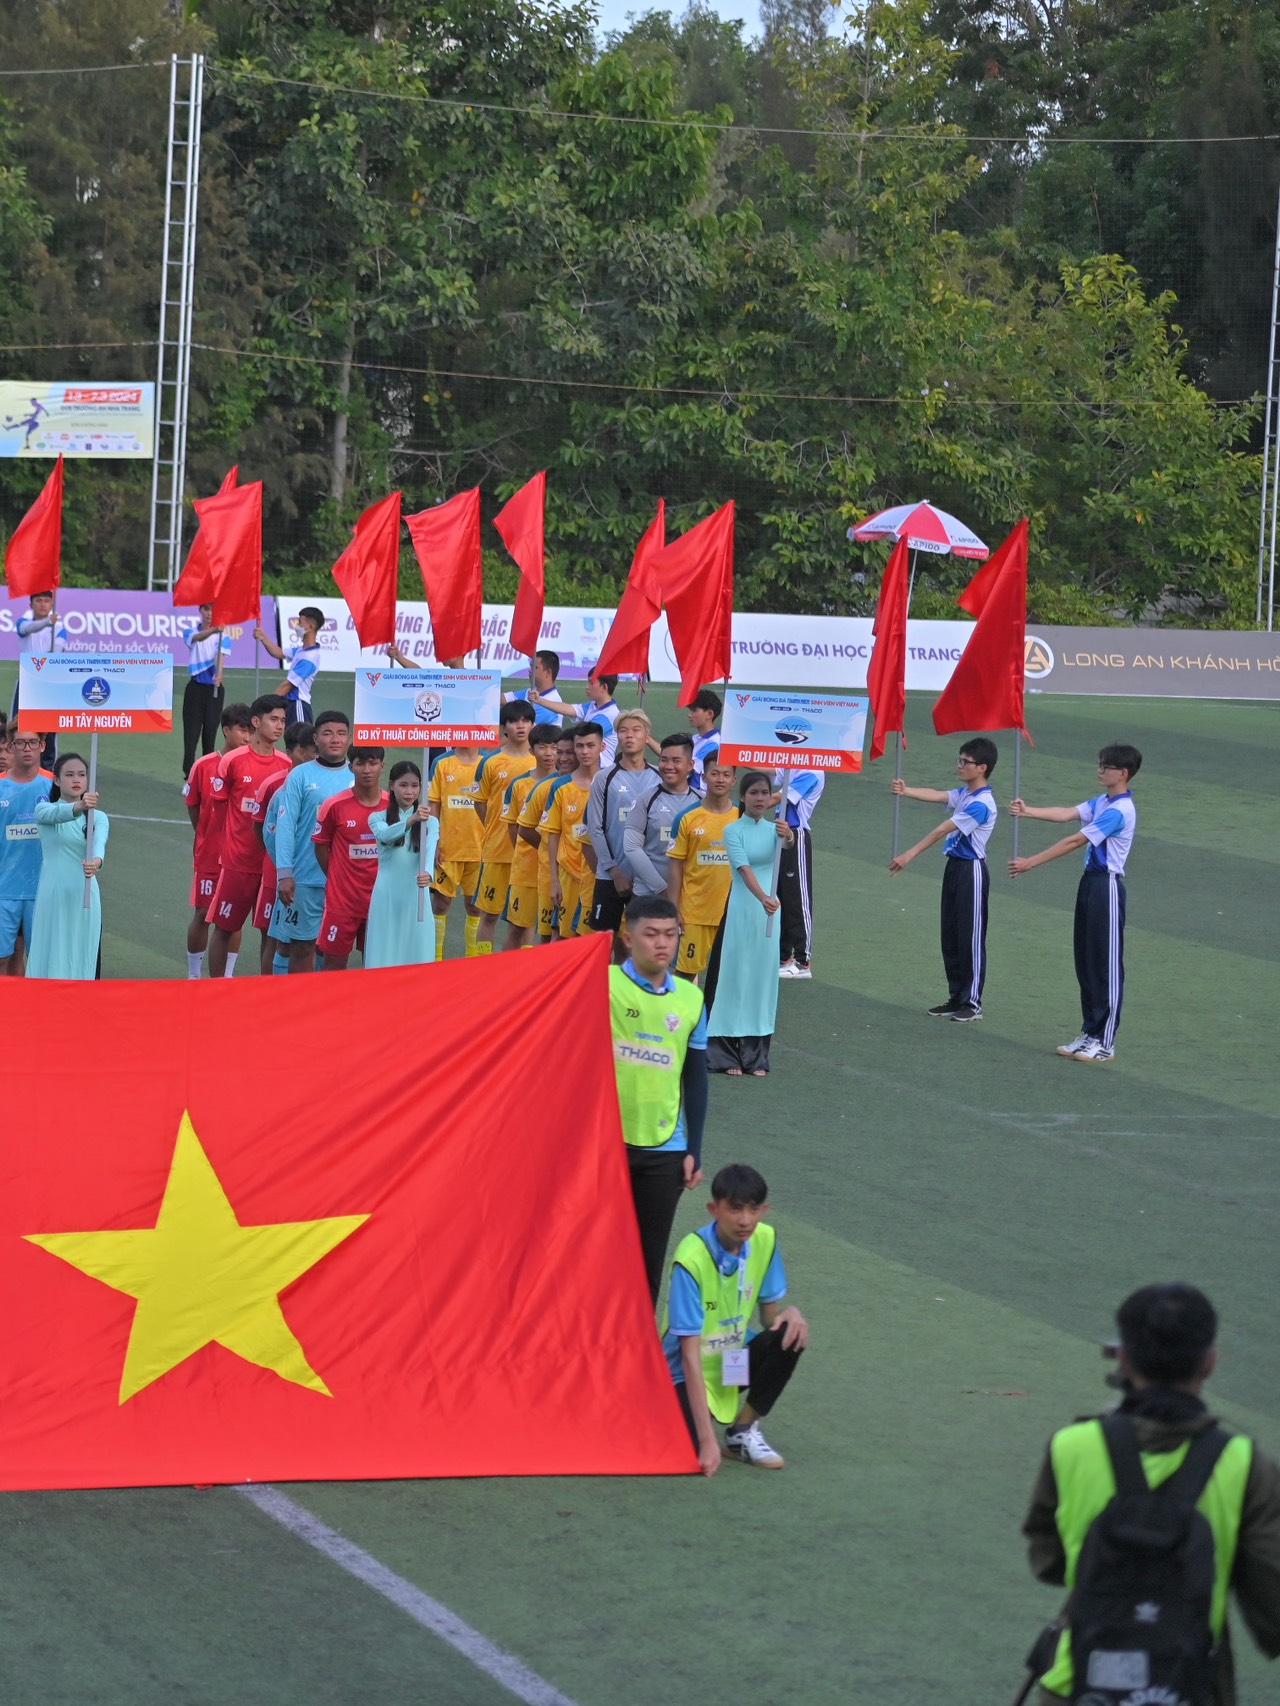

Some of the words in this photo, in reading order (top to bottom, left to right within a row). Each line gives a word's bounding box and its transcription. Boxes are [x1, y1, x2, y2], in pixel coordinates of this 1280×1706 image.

[65, 640, 97, 653] ưởng
[290, 634, 339, 646] OGA
[732, 639, 798, 656] TRƯỜNG
[802, 642, 829, 660] ĐẠI
[833, 645, 868, 661] HỌC
[909, 647, 961, 661] TRANG
[1063, 652, 1125, 667] LONG
[1132, 655, 1164, 669] AN
[1171, 654, 1251, 671] KHÁNH
[59, 715, 73, 728] ĐH
[75, 712, 92, 728] TÂY
[95, 712, 132, 728] NGUYÊN
[358, 730, 369, 740] CĐ
[370, 727, 381, 740] KỸ
[382, 729, 406, 742] THUẬT
[408, 727, 429, 740] CÔNG
[431, 728, 452, 743] NGHỆ
[453, 730, 468, 740] NHA
[471, 730, 495, 741] TRANG
[739, 751, 752, 762] CĐ
[753, 752, 766, 763] DU
[768, 753, 789, 767] LỊCH
[792, 753, 810, 765] NHA
[812, 755, 841, 767] TRANG
[10, 828, 38, 836] THAC
[201, 880, 212, 896] 16
[484, 885, 496, 901] 14
[219, 901, 233, 919] 14
[512, 897, 519, 912] 4
[595, 904, 602, 919] 1
[285, 908, 298, 926] 24
[328, 925, 338, 941] 3
[620, 1045, 670, 1065] THACO
